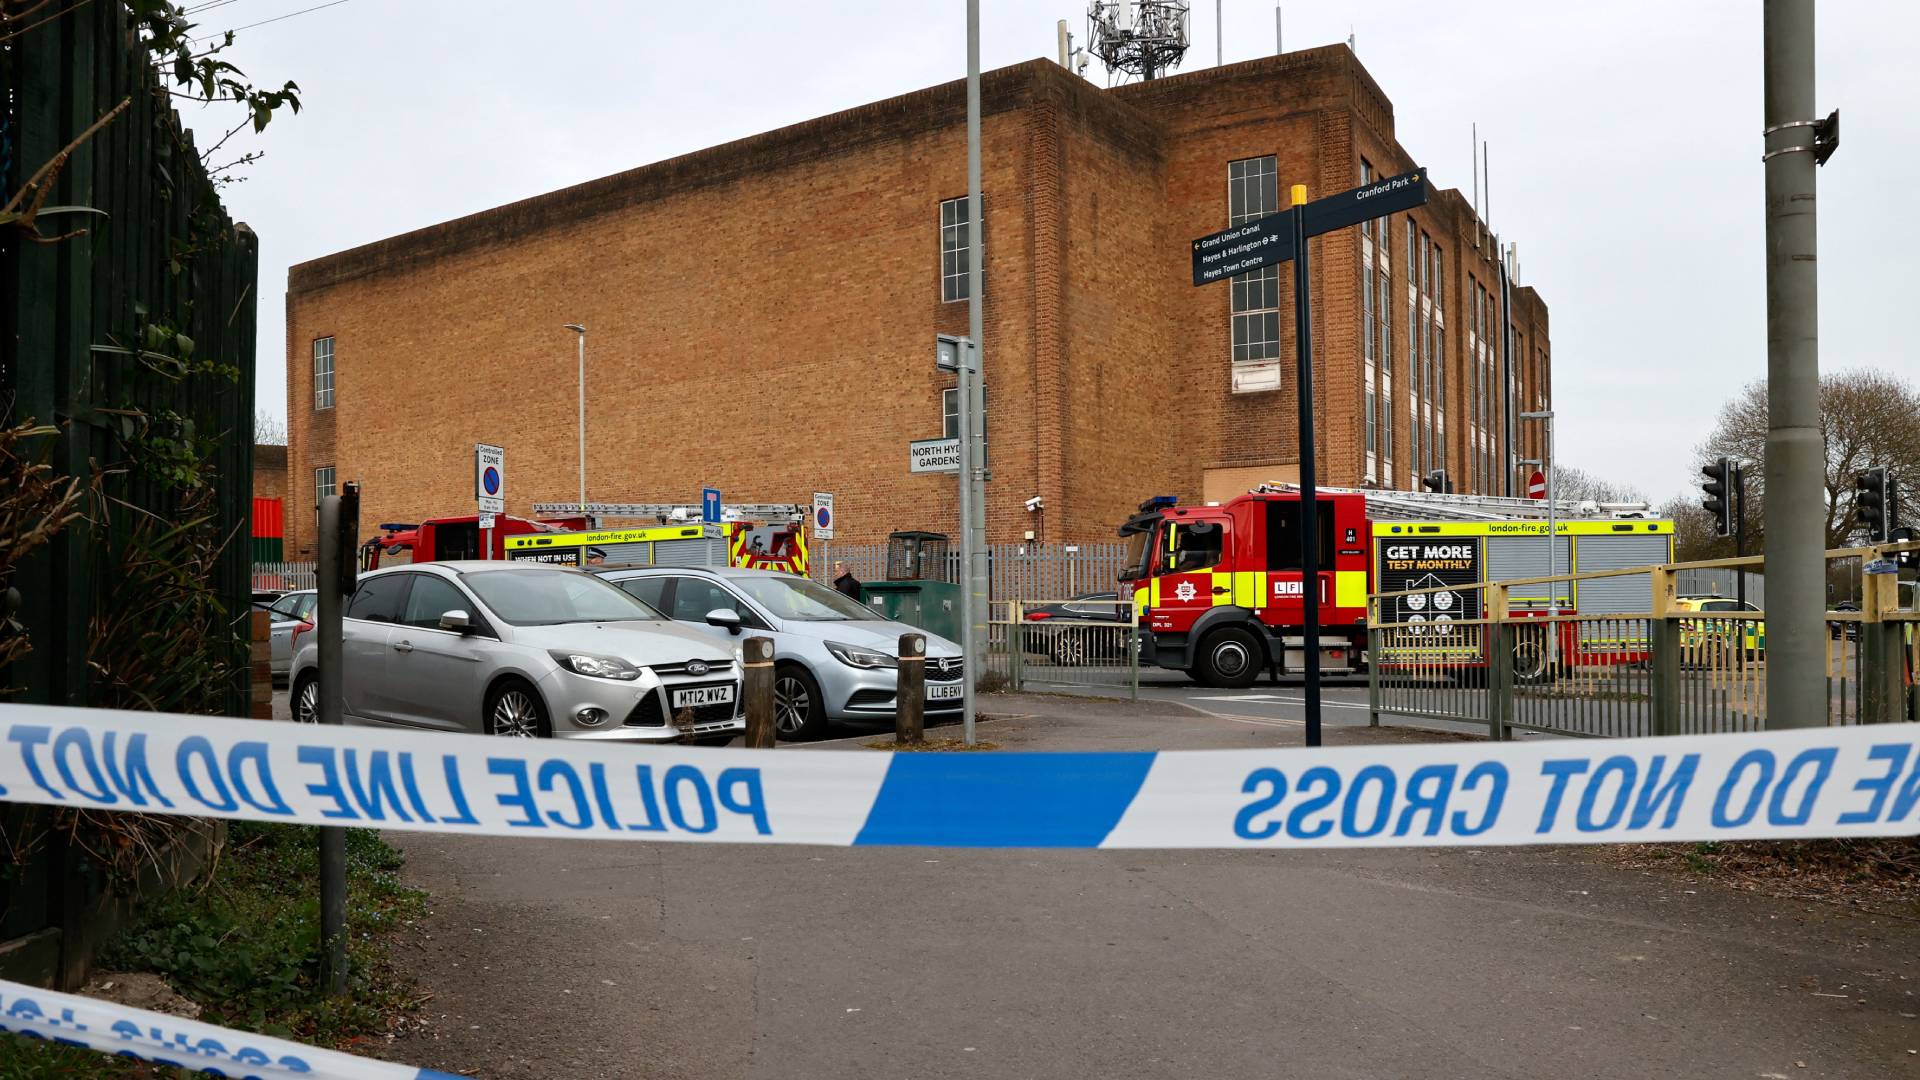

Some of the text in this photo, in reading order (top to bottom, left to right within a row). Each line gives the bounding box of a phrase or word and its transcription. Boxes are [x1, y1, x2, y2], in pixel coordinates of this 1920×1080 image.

[1356, 177, 1409, 200] Cranford Park
[1201, 223, 1261, 249] Grand Union Canal
[1202, 240, 1262, 264] Hayes & Harlington
[1203, 256, 1263, 279] Hayes Town Centre
[479, 446, 503, 456] Controlled
[912, 444, 960, 457] NORTH HYD
[483, 455, 499, 465] ZONE
[919, 455, 960, 467] GARDENS
[1488, 523, 1569, 534] london-fire.go.uk
[586, 530, 647, 542] london-fire.gov.uk
[537, 554, 553, 563] NOT
[553, 554, 562, 562] IN
[562, 553, 577, 562] USE
[1386, 545, 1472, 560] GET MORE
[1386, 560, 1472, 570] TEST MONTHLY
[680, 687, 727, 705] MT12 WVZ
[931, 685, 962, 699] LL16 EKV
